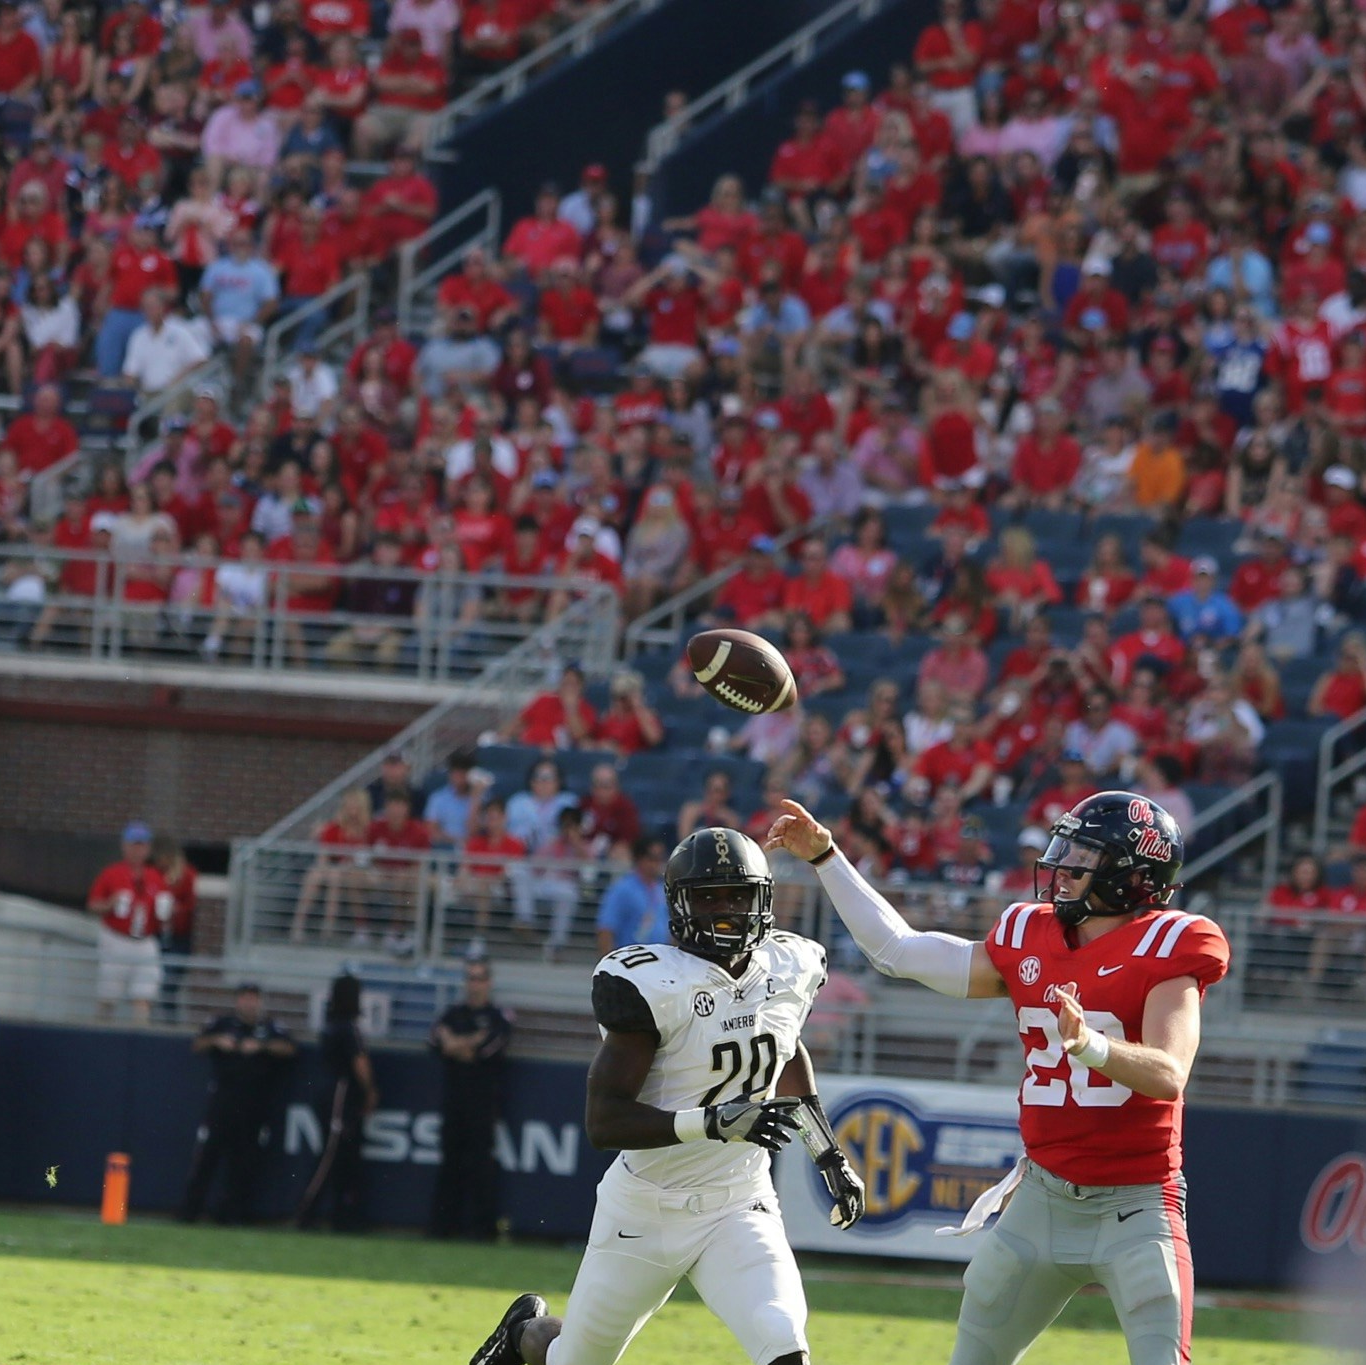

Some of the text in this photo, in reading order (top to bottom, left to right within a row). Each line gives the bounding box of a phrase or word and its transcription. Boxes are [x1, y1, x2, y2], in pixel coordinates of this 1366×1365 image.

[1129, 800, 1155, 825] Ole
[1136, 826, 1172, 862] Miss
[1020, 957, 1039, 984] SEC
[694, 992, 715, 1017] SEC
[698, 1033, 777, 1107] 20
[1018, 1006, 1133, 1107] 20
[835, 1106, 926, 1216] SEC
